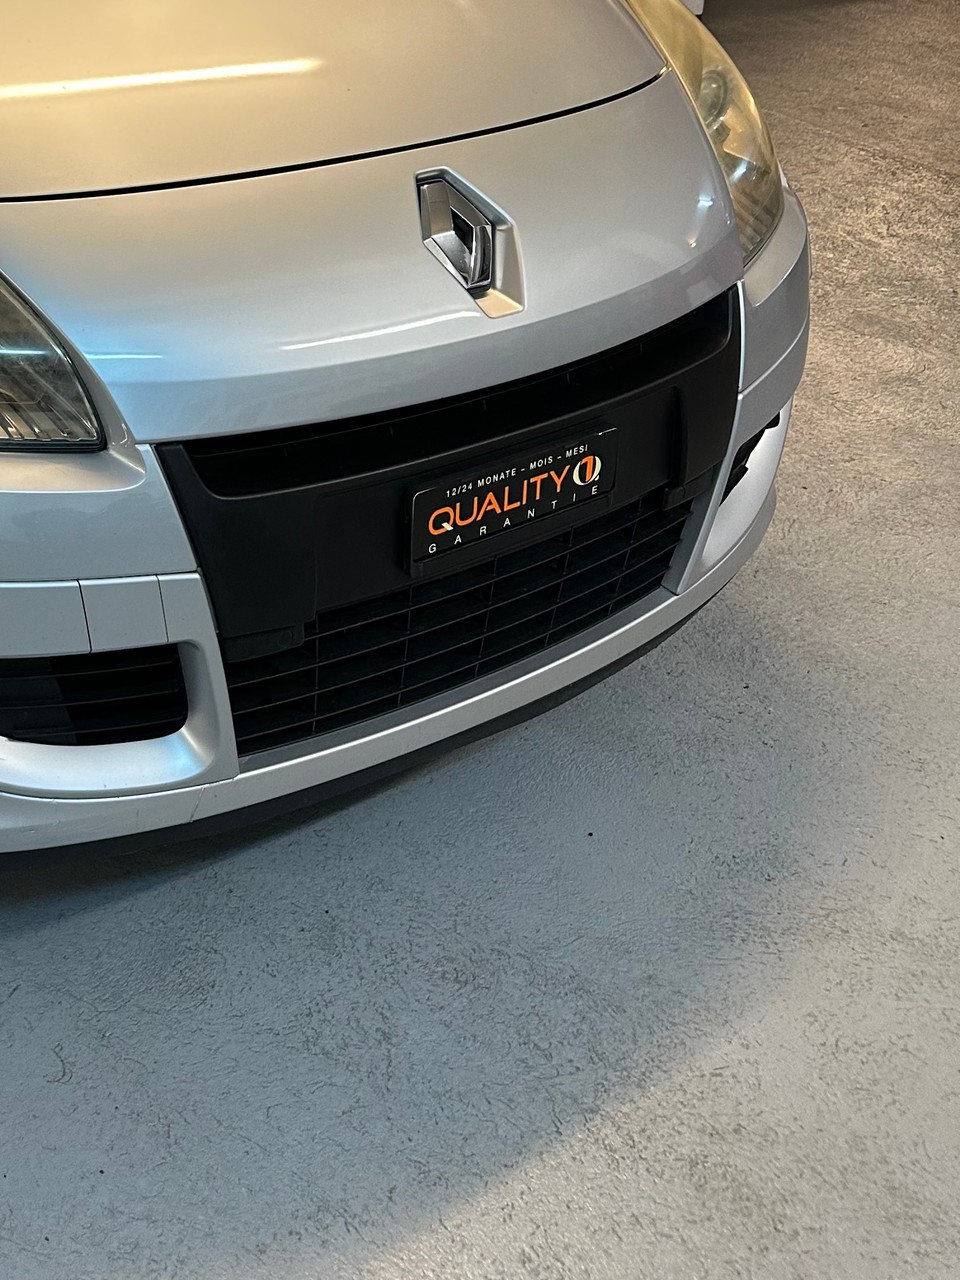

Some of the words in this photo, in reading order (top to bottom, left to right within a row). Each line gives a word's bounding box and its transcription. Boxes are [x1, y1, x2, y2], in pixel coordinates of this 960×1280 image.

[446, 482, 473, 498] 12/24
[477, 467, 517, 487] MONATE
[529, 456, 553, 471] MOIS
[565, 444, 589, 459] MESI
[428, 485, 599, 554] GARANTIE
